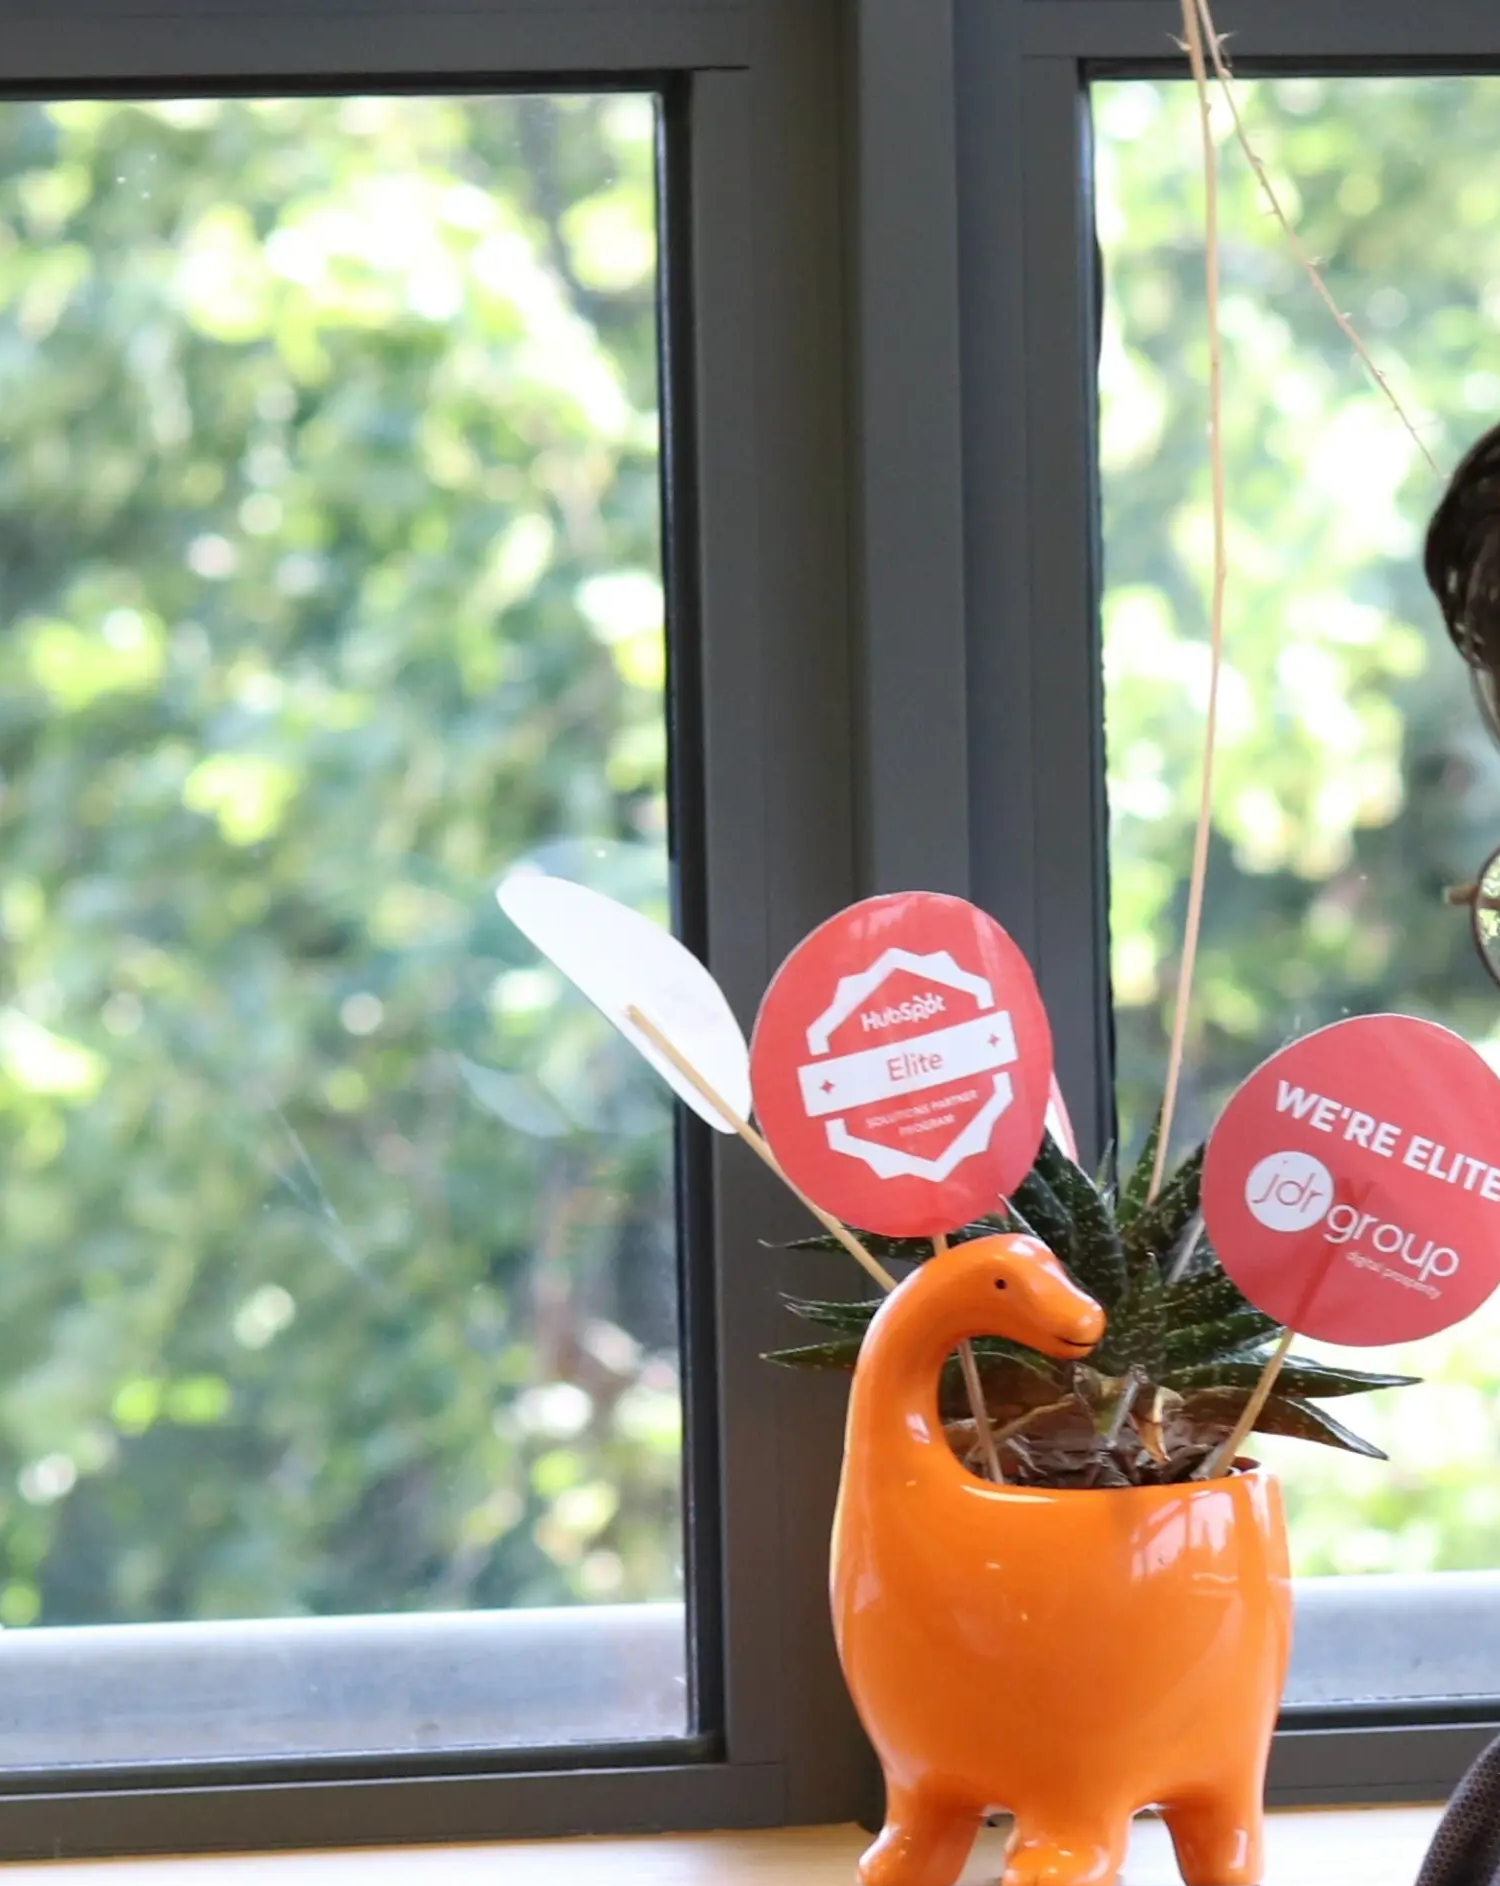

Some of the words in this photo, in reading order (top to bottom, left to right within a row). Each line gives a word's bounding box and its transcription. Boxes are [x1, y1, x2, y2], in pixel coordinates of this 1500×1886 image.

[860, 992, 946, 1032] HubSpot
[886, 1053, 943, 1081] Elite
[1275, 1079, 1402, 1158] WE'RE
[1251, 1160, 1324, 1213] jdr
[1323, 1203, 1459, 1282] group
